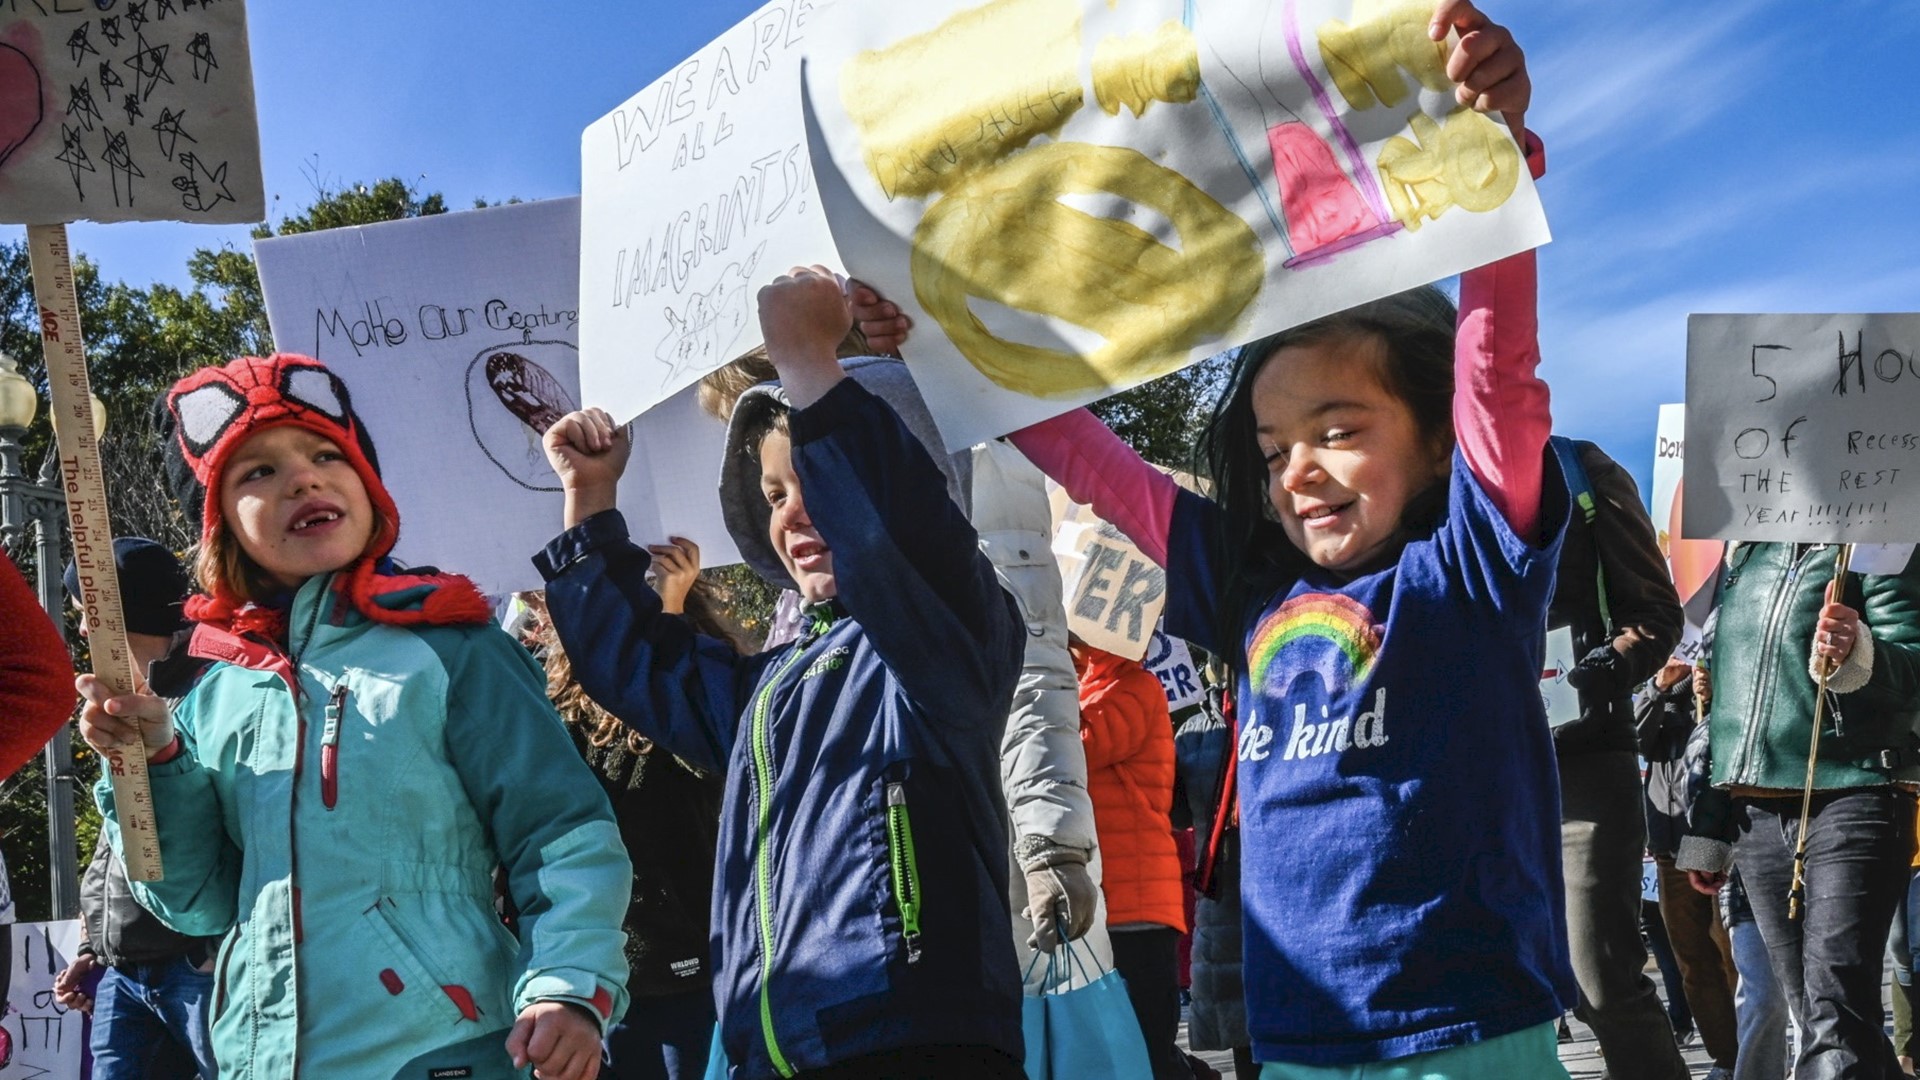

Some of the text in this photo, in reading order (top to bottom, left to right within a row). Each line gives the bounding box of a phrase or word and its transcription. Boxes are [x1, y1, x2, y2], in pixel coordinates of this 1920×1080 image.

[612, 59, 699, 171] WE
[671, 111, 734, 171] ALL
[39, 304, 60, 343] ACE
[316, 298, 408, 360] Make
[419, 303, 475, 340] Our
[1752, 343, 1793, 403] 5
[1740, 468, 1901, 494] THE REST
[63, 455, 101, 633] The helpful place.
[1238, 686, 1390, 762] be kind
